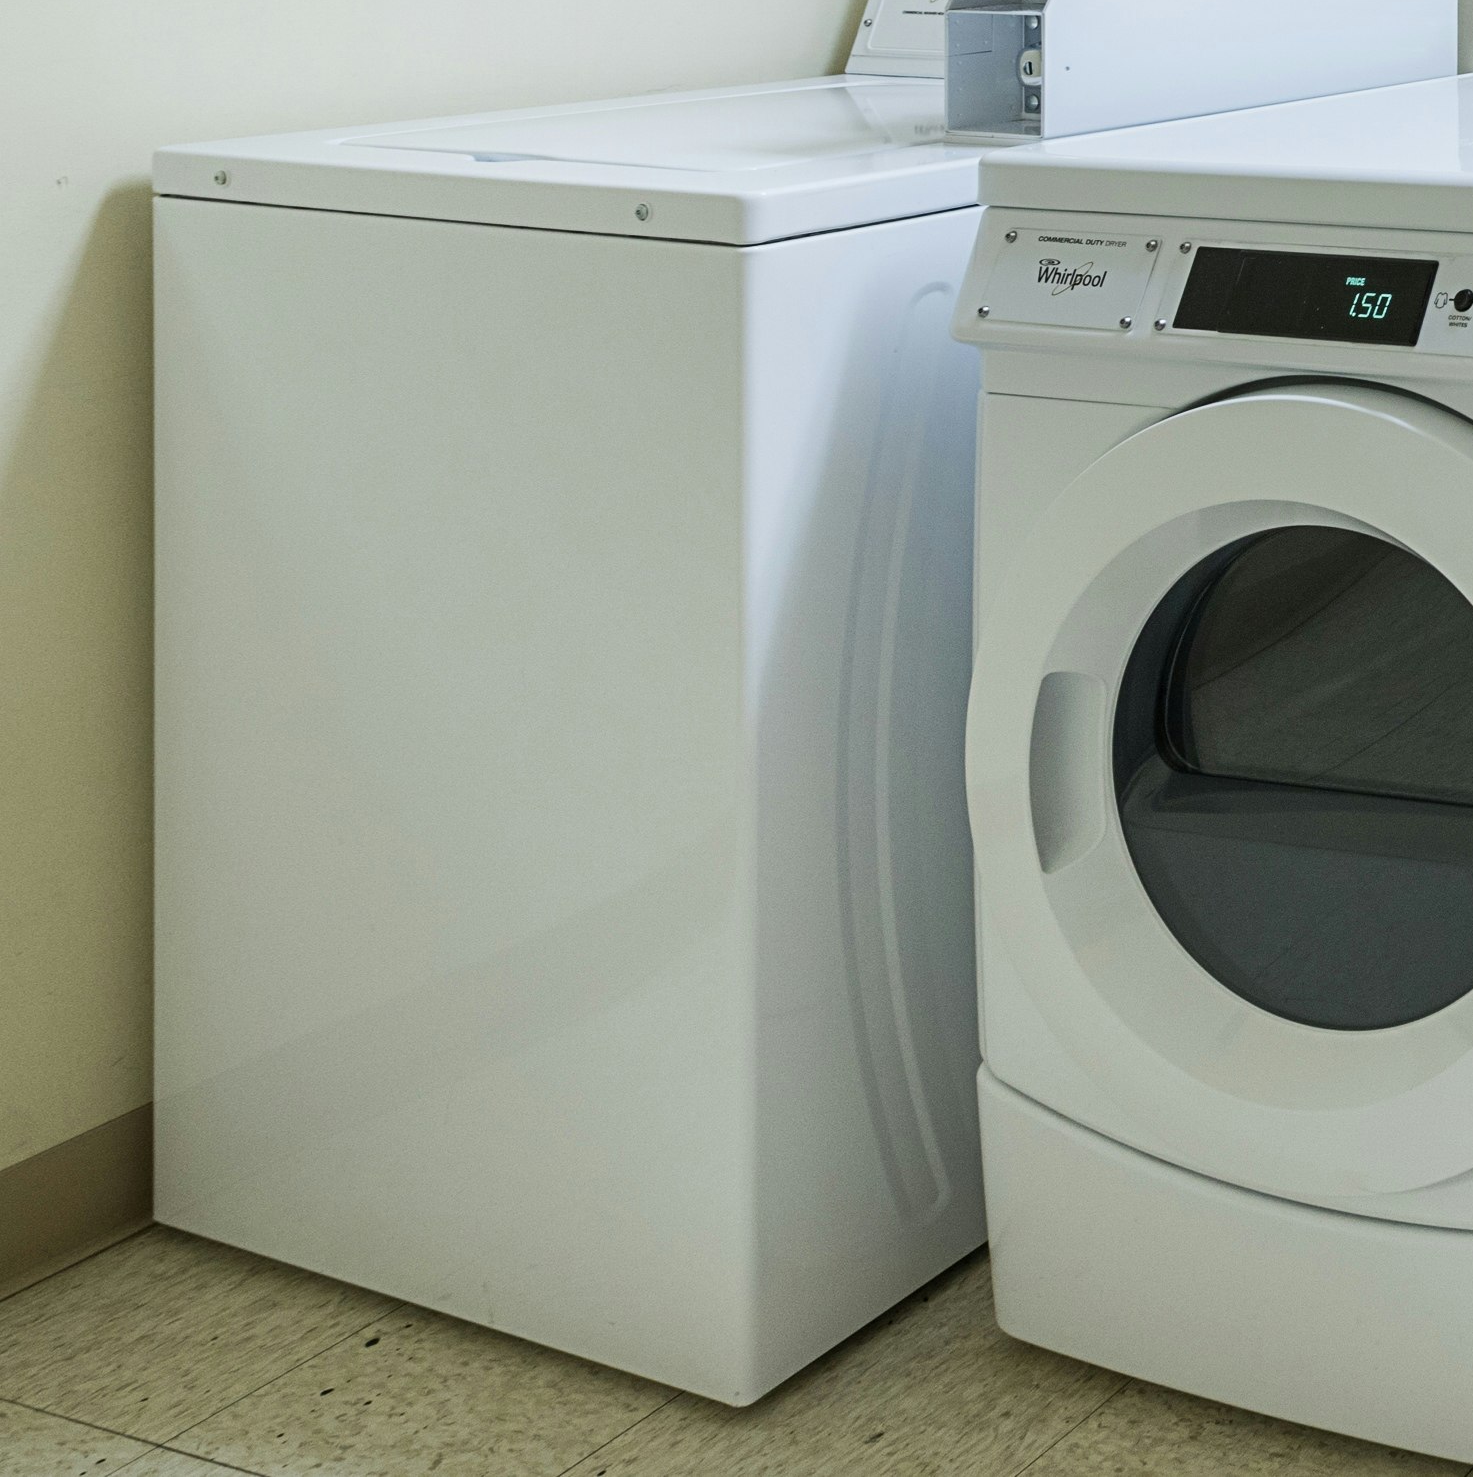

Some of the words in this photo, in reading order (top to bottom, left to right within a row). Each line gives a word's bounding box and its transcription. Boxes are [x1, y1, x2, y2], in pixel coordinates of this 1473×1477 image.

[1038, 236, 1083, 244] COMMERCIAL
[1038, 266, 1107, 290] Whirlpool
[1346, 277, 1366, 286] PRICE
[1350, 292, 1392, 319] 1.50
